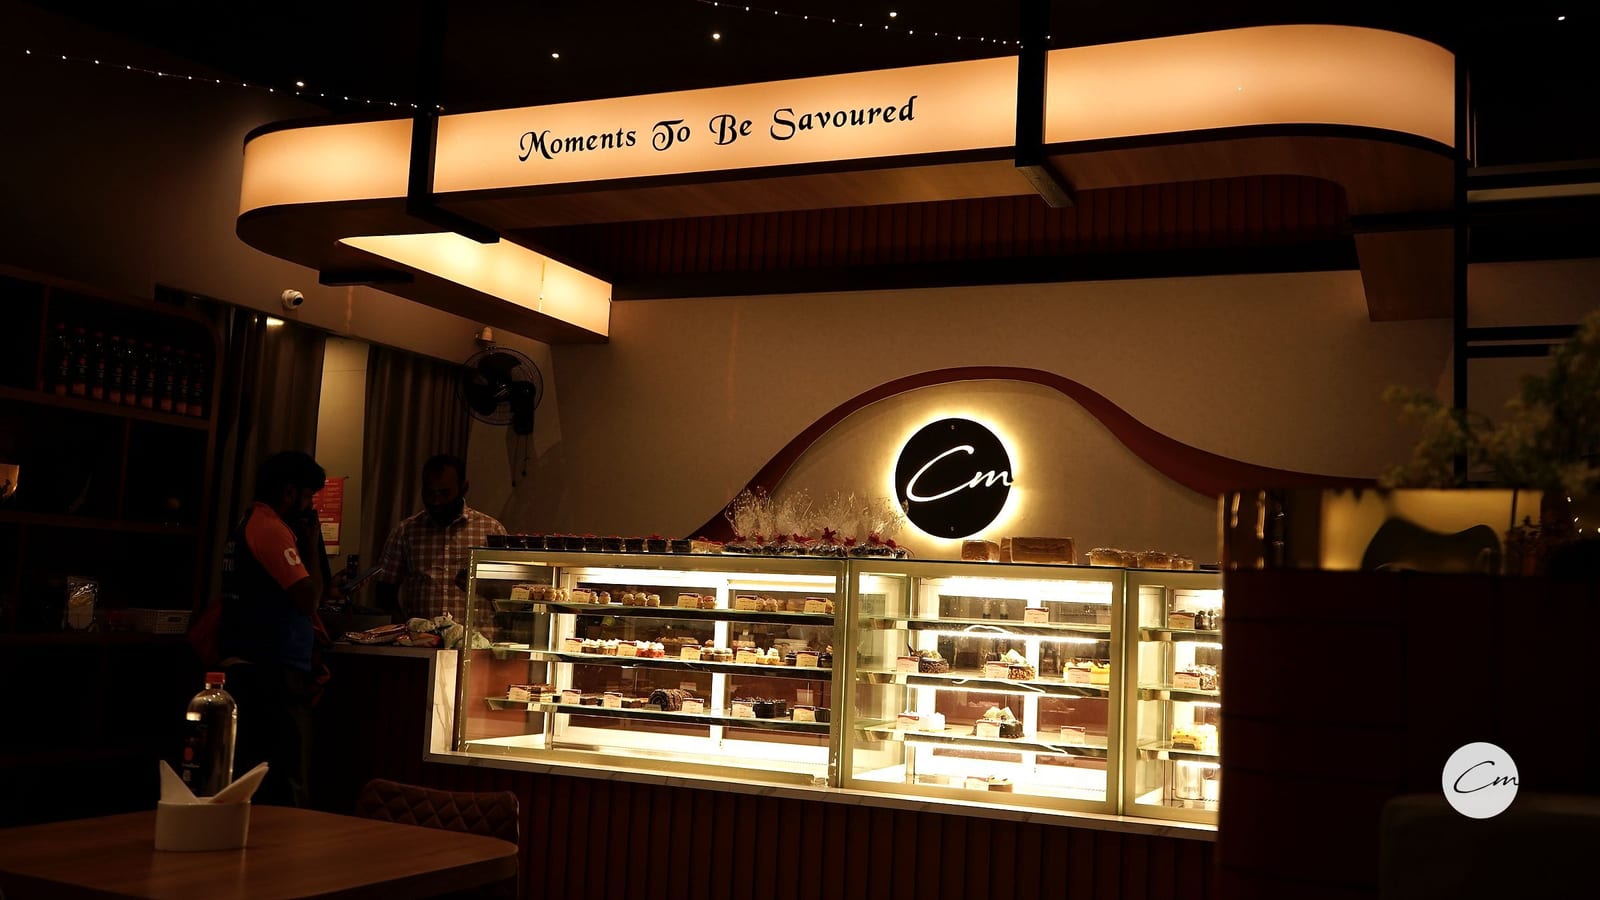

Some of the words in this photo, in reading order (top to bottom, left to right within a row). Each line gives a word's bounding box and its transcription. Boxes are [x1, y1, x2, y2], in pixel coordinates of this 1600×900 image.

[518, 127, 637, 162] Moments
[652, 119, 691, 152] To
[708, 114, 753, 146] Be
[769, 95, 918, 141] Savoured
